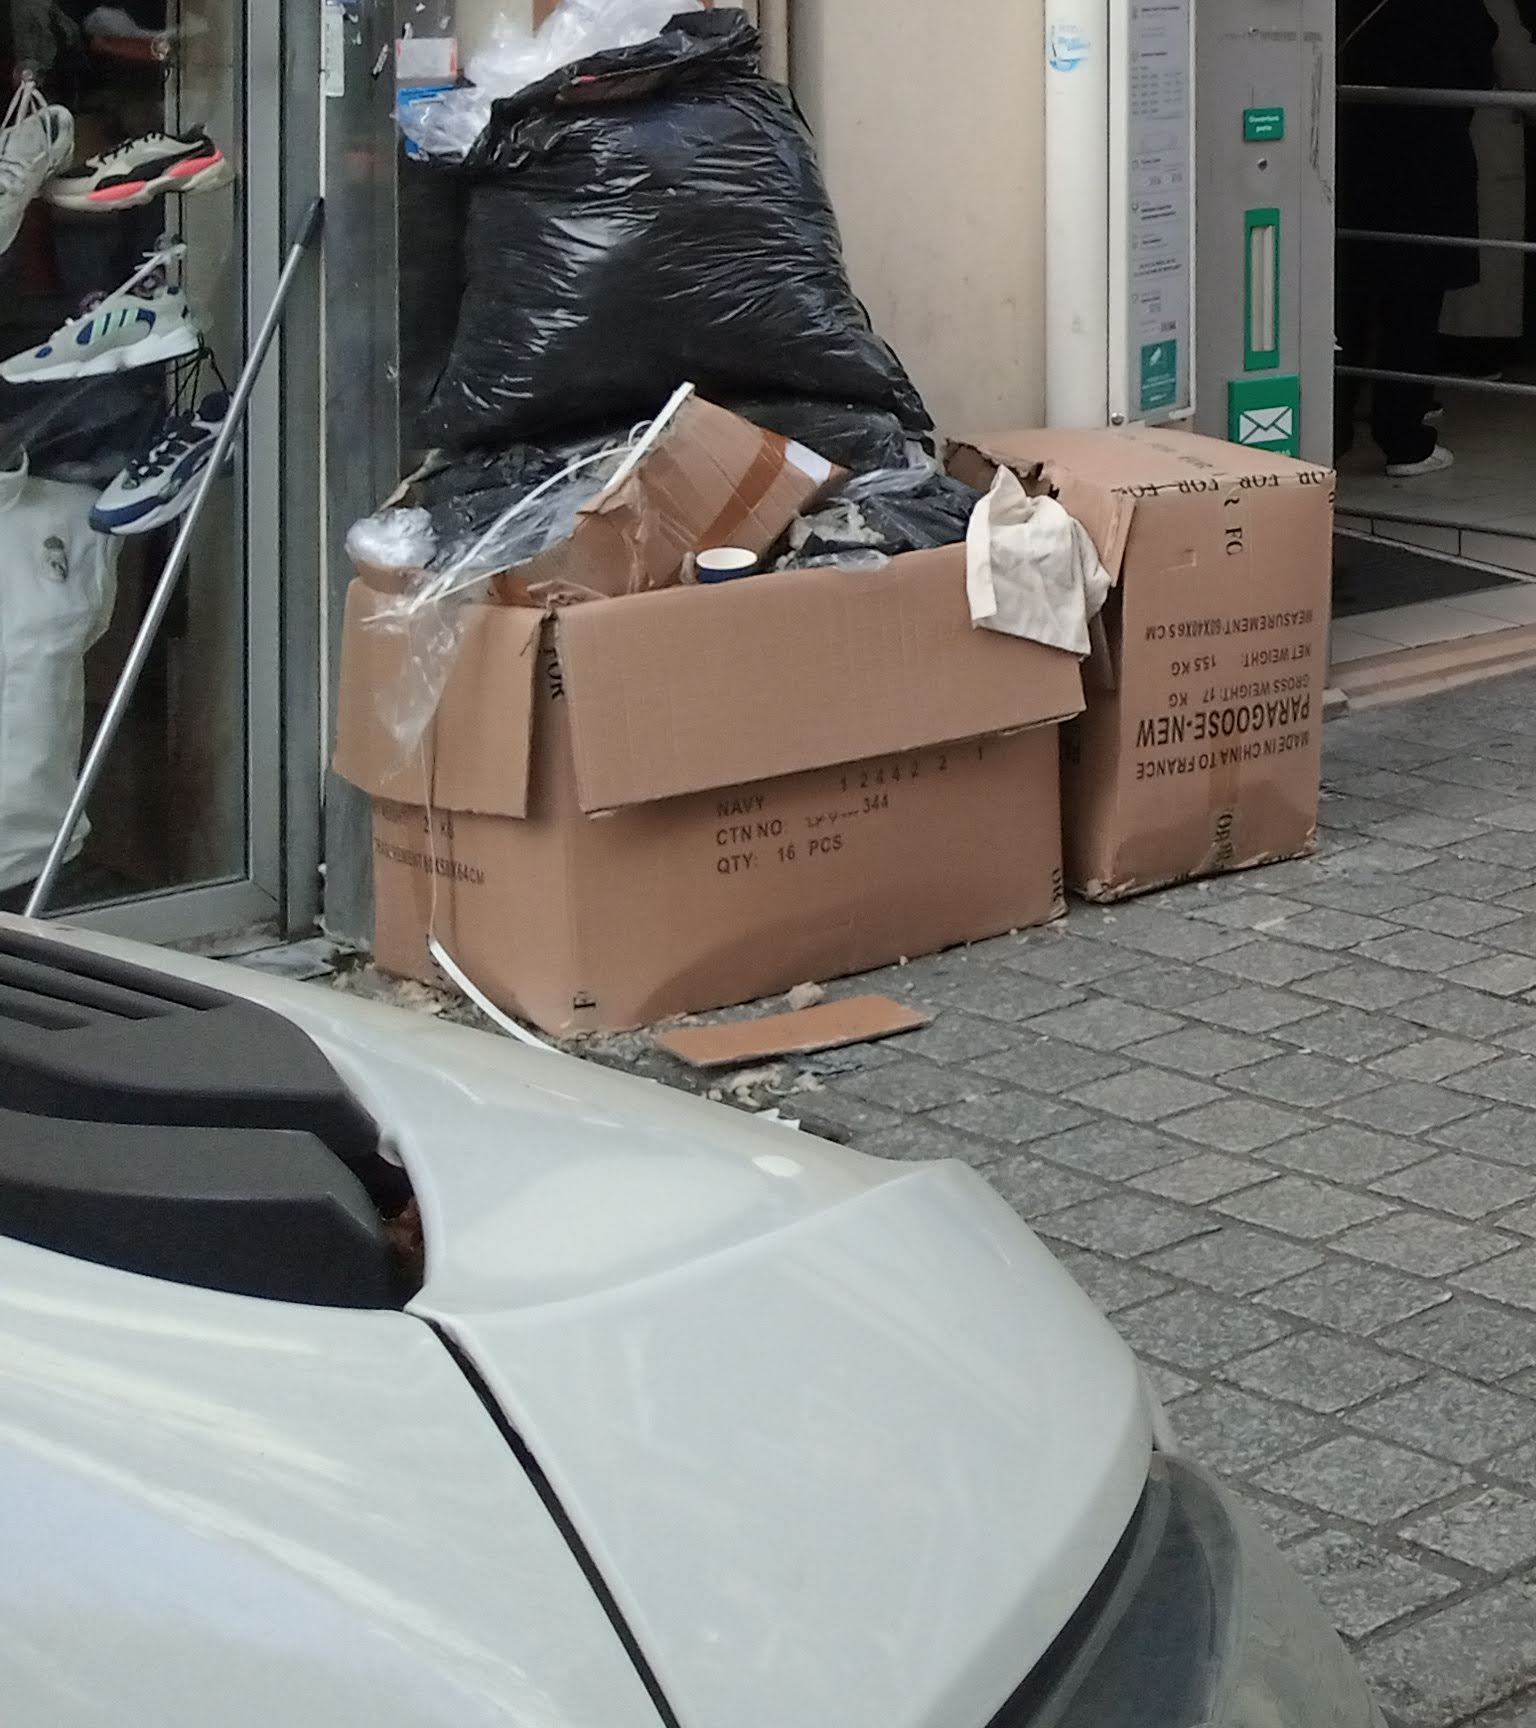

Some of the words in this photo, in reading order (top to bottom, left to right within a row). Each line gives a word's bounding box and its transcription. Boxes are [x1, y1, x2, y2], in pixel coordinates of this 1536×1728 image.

[1145, 625, 1167, 642] CM
[1170, 660, 1191, 677] KG
[1273, 672, 1311, 693] GROSS
[1168, 691, 1189, 708] KG
[1202, 688, 1216, 704] 17
[1135, 692, 1311, 748] PARAGOOSE-NEW
[1262, 738, 1277, 758] IN
[1276, 729, 1310, 755] MADE
[1199, 750, 1217, 770] TO
[1219, 741, 1262, 766] CHINA
[1135, 752, 1195, 781] FRANCE
[716, 795, 765, 818] NAVY
[715, 827, 752, 847] CTN
[776, 843, 796, 864] 16
[808, 833, 844, 857] PCS
